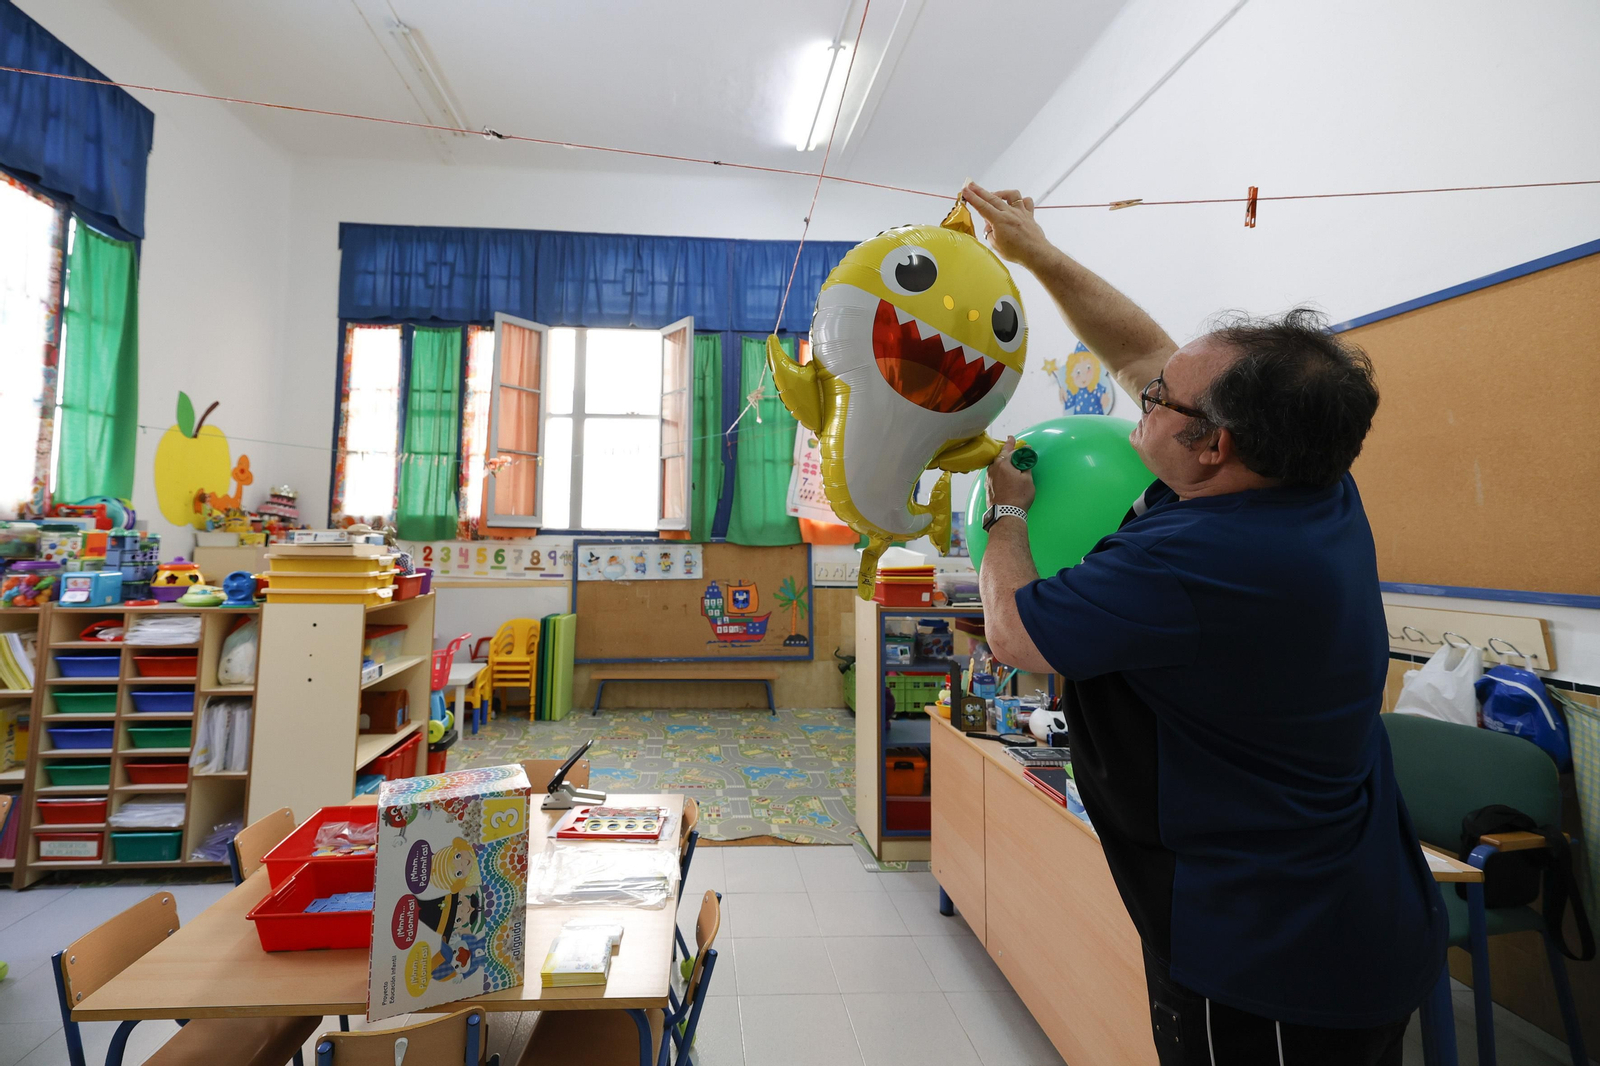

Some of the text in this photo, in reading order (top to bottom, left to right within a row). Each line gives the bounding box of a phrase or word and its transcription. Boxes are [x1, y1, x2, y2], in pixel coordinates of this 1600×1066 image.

[804, 452, 812, 461] 4
[802, 477, 809, 486] 7
[422, 545, 433, 562] 2
[440, 546, 451, 563] 3
[458, 546, 469, 564] 4
[476, 547, 488, 564] 5
[493, 548, 506, 565] 6
[512, 548, 524, 565] 7
[529, 549, 541, 566] 8
[547, 550, 557, 566] 9
[490, 807, 519, 829] 3
[418, 844, 429, 887] Palomitas!
[405, 898, 415, 942] Palomitas!
[511, 921, 523, 956] algaida
[419, 945, 429, 989] Palomitas!
[381, 981, 389, 1006] Proyecto
